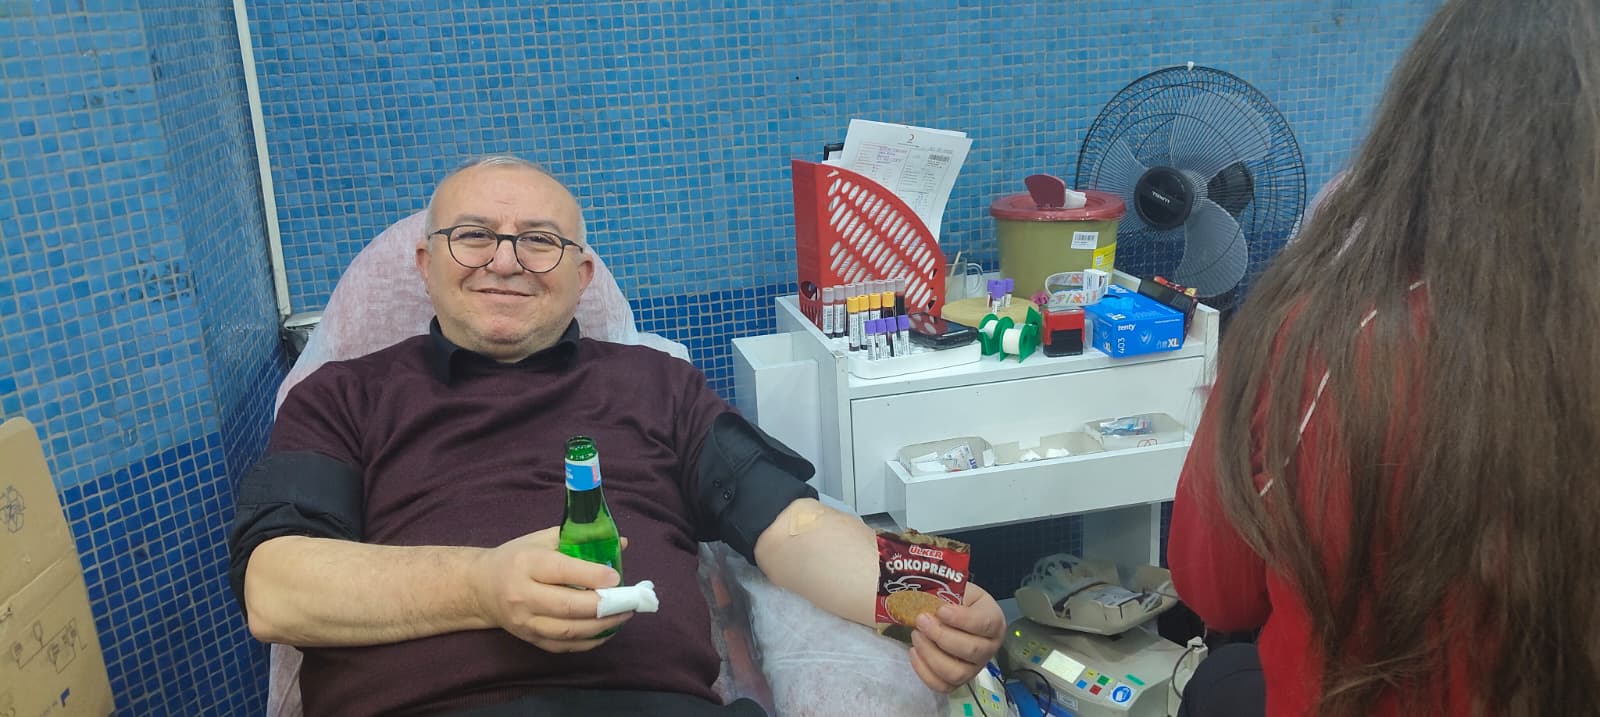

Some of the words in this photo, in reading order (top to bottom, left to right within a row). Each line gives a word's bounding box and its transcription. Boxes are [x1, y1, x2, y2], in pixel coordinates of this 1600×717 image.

[1117, 337, 1126, 354] 403
[1168, 338, 1180, 348] XL
[909, 545, 944, 560] ÜLKER
[886, 559, 964, 583] ÇOKOPRENS
